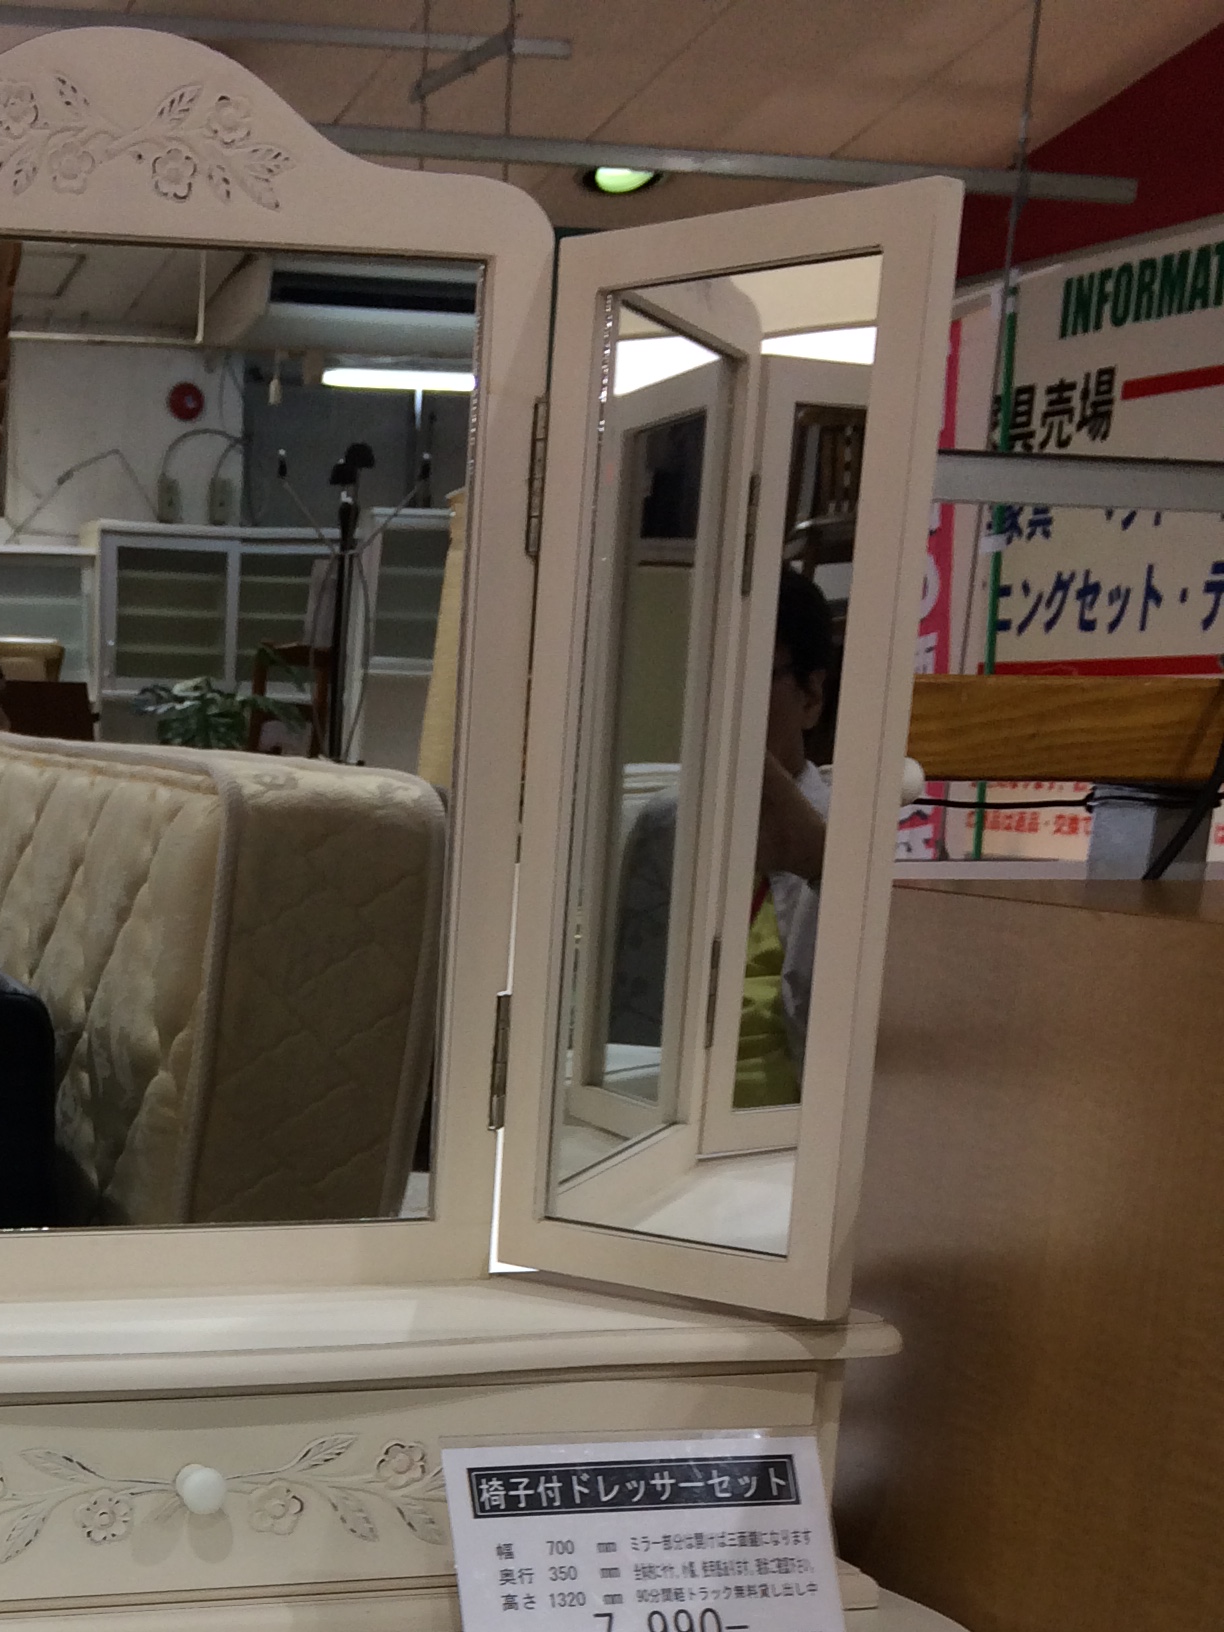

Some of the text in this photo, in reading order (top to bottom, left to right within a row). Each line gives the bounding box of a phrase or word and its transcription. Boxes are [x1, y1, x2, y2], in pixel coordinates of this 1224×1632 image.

[477, 1467, 787, 1511] 椅子付ドレッサーセット
[546, 1540, 575, 1555] 700
[499, 1567, 535, 1586] 奥行
[548, 1566, 578, 1581] 350
[501, 1593, 536, 1611] 高さ
[549, 1591, 587, 1608] 1320
